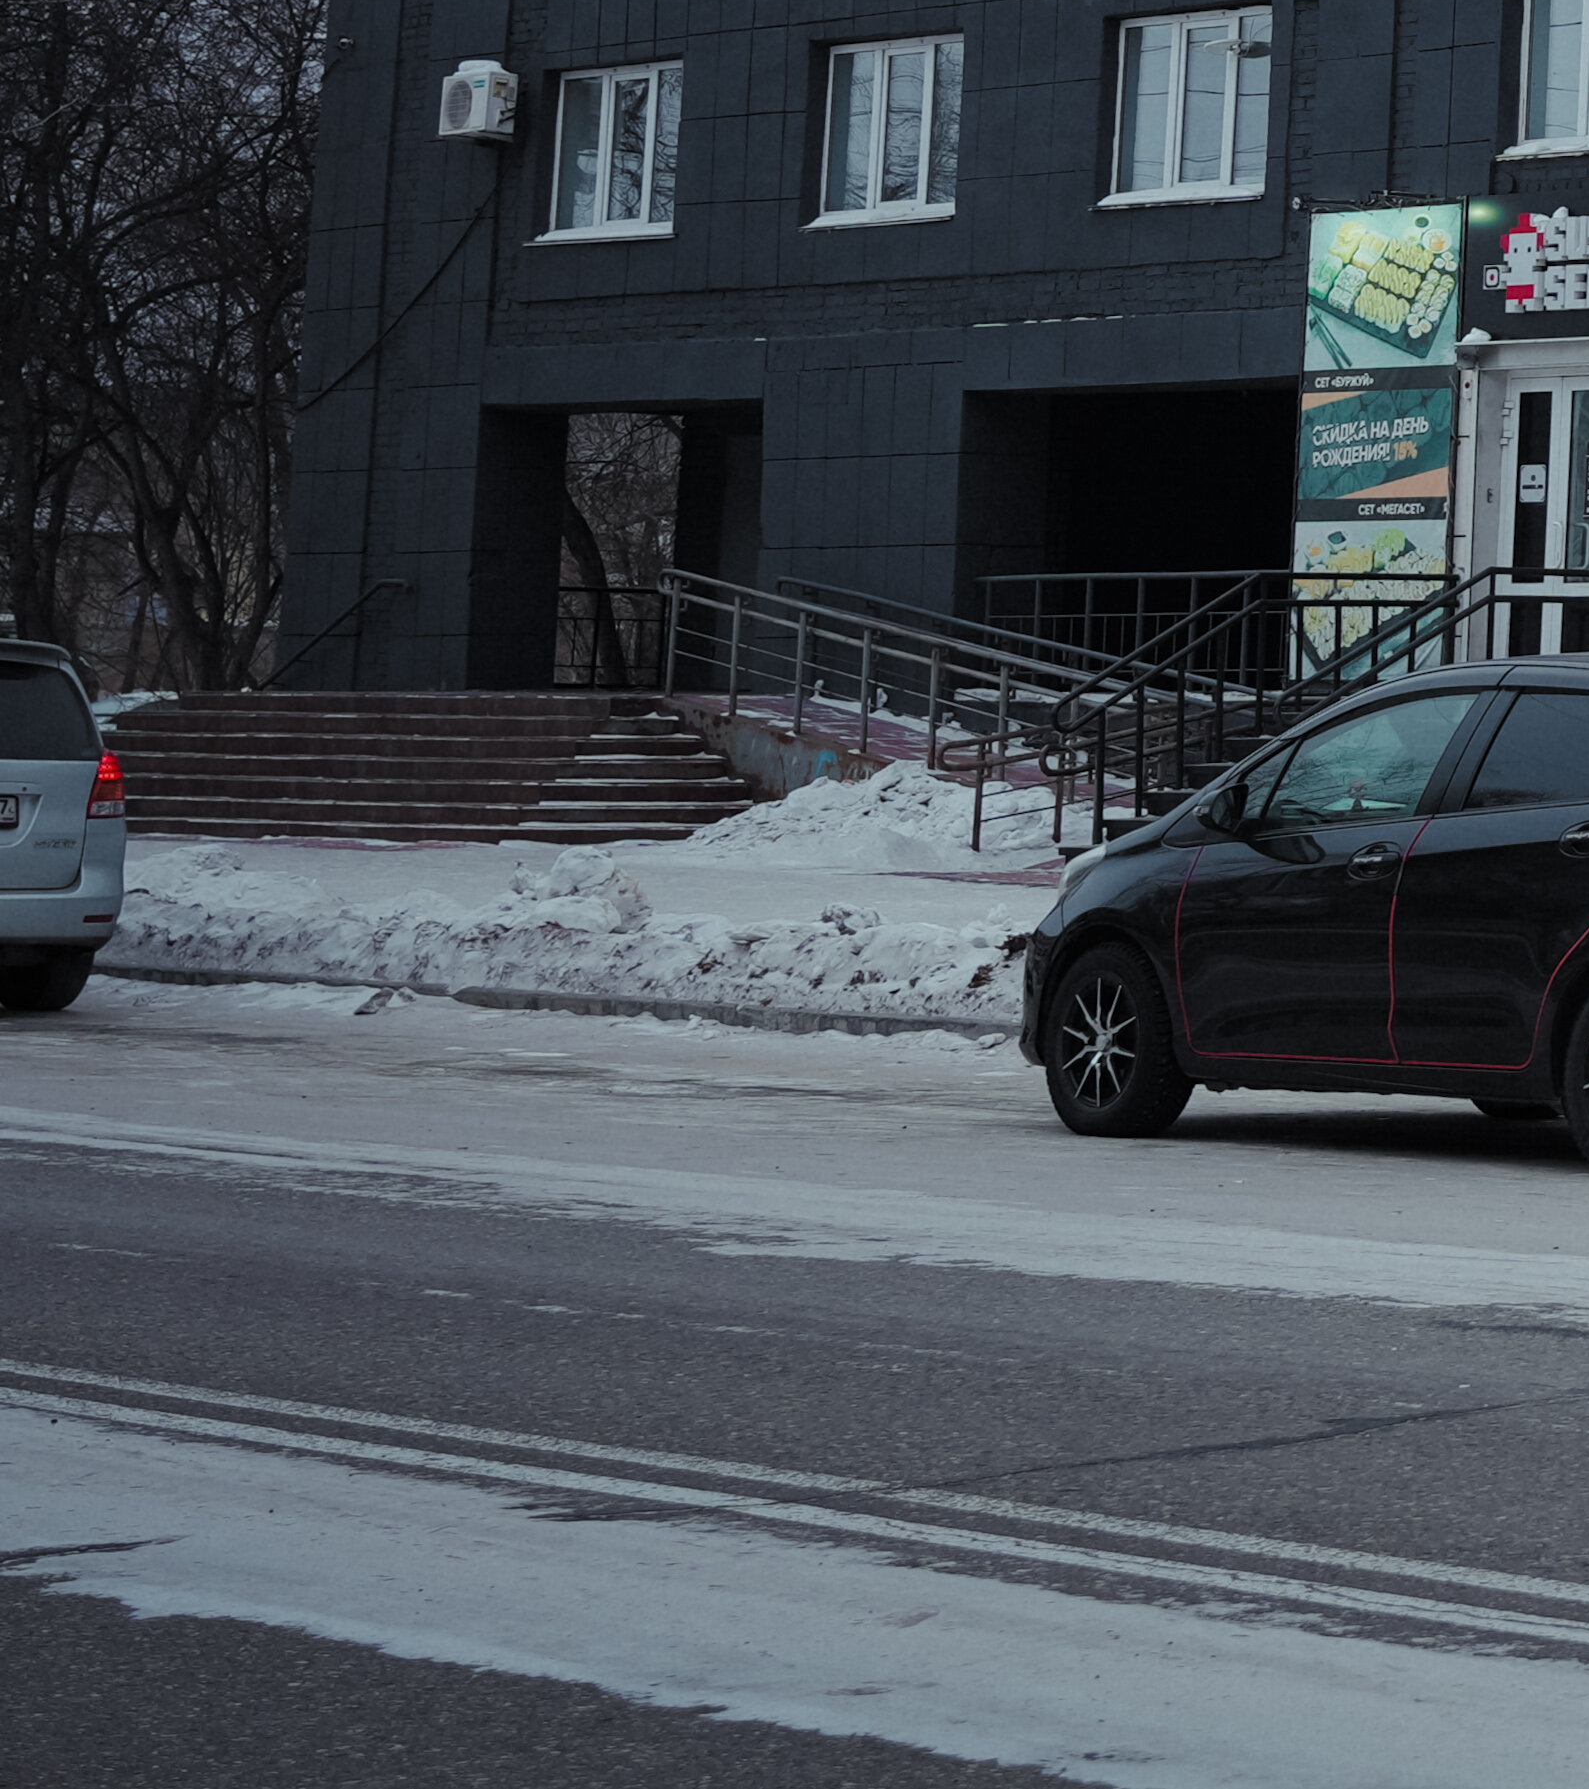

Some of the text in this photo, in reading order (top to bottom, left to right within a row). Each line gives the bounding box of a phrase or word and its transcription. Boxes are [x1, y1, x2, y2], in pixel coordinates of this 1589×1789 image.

[1314, 376, 1331, 388] СЕТ
[1312, 416, 1430, 446] СКИДКА НА ДЕНЬ
[1312, 442, 1391, 468] РОЖДЕНИЯ!
[1358, 503, 1376, 516] СЕТ
